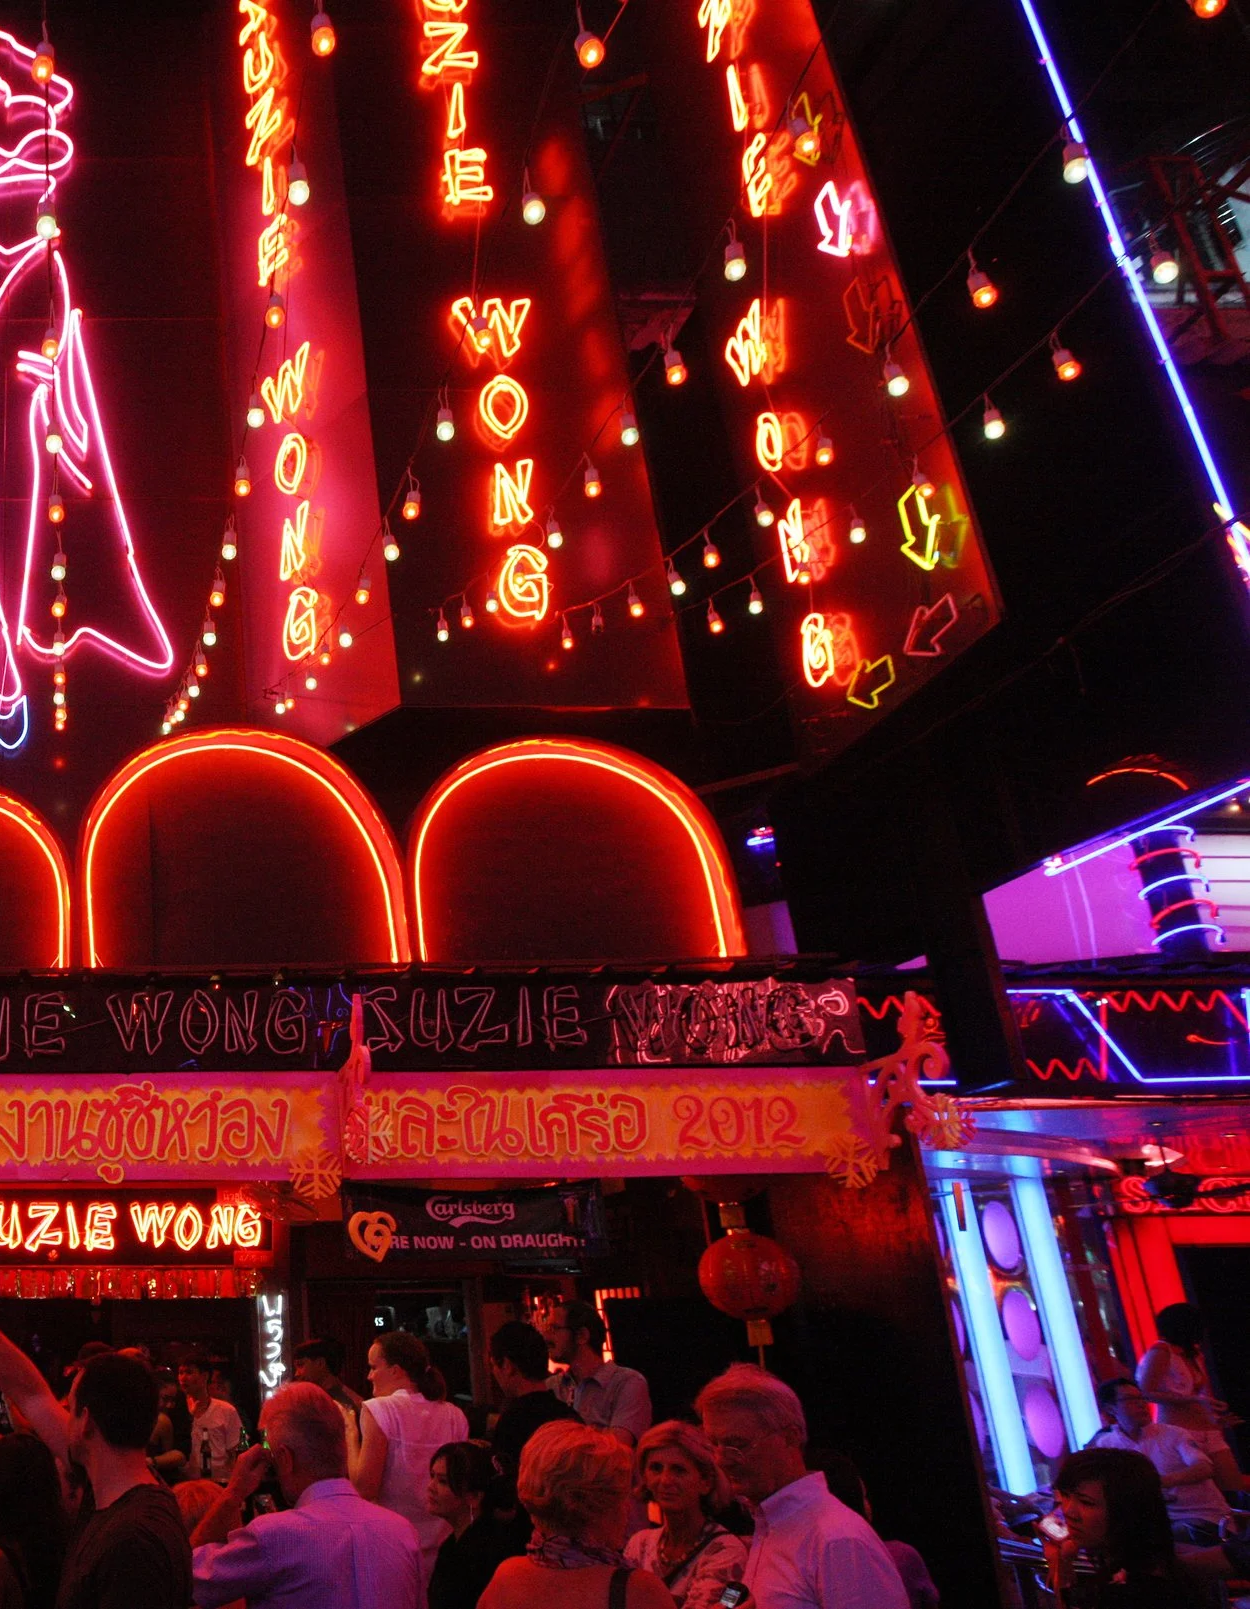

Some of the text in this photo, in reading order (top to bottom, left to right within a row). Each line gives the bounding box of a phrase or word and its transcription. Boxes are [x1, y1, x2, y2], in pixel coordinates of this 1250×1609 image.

[451, 297, 548, 621] WONG
[261, 341, 318, 661] WONG
[725, 298, 835, 688] WONG
[107, 989, 308, 1055] WONG
[363, 985, 588, 1053] SUZIE
[673, 1093, 810, 1152] 2012
[129, 1200, 263, 1251] WONG
[413, 1235, 454, 1250] NOW
[470, 1235, 497, 1250] ON
[425, 1195, 517, 1226] Carlsberg
